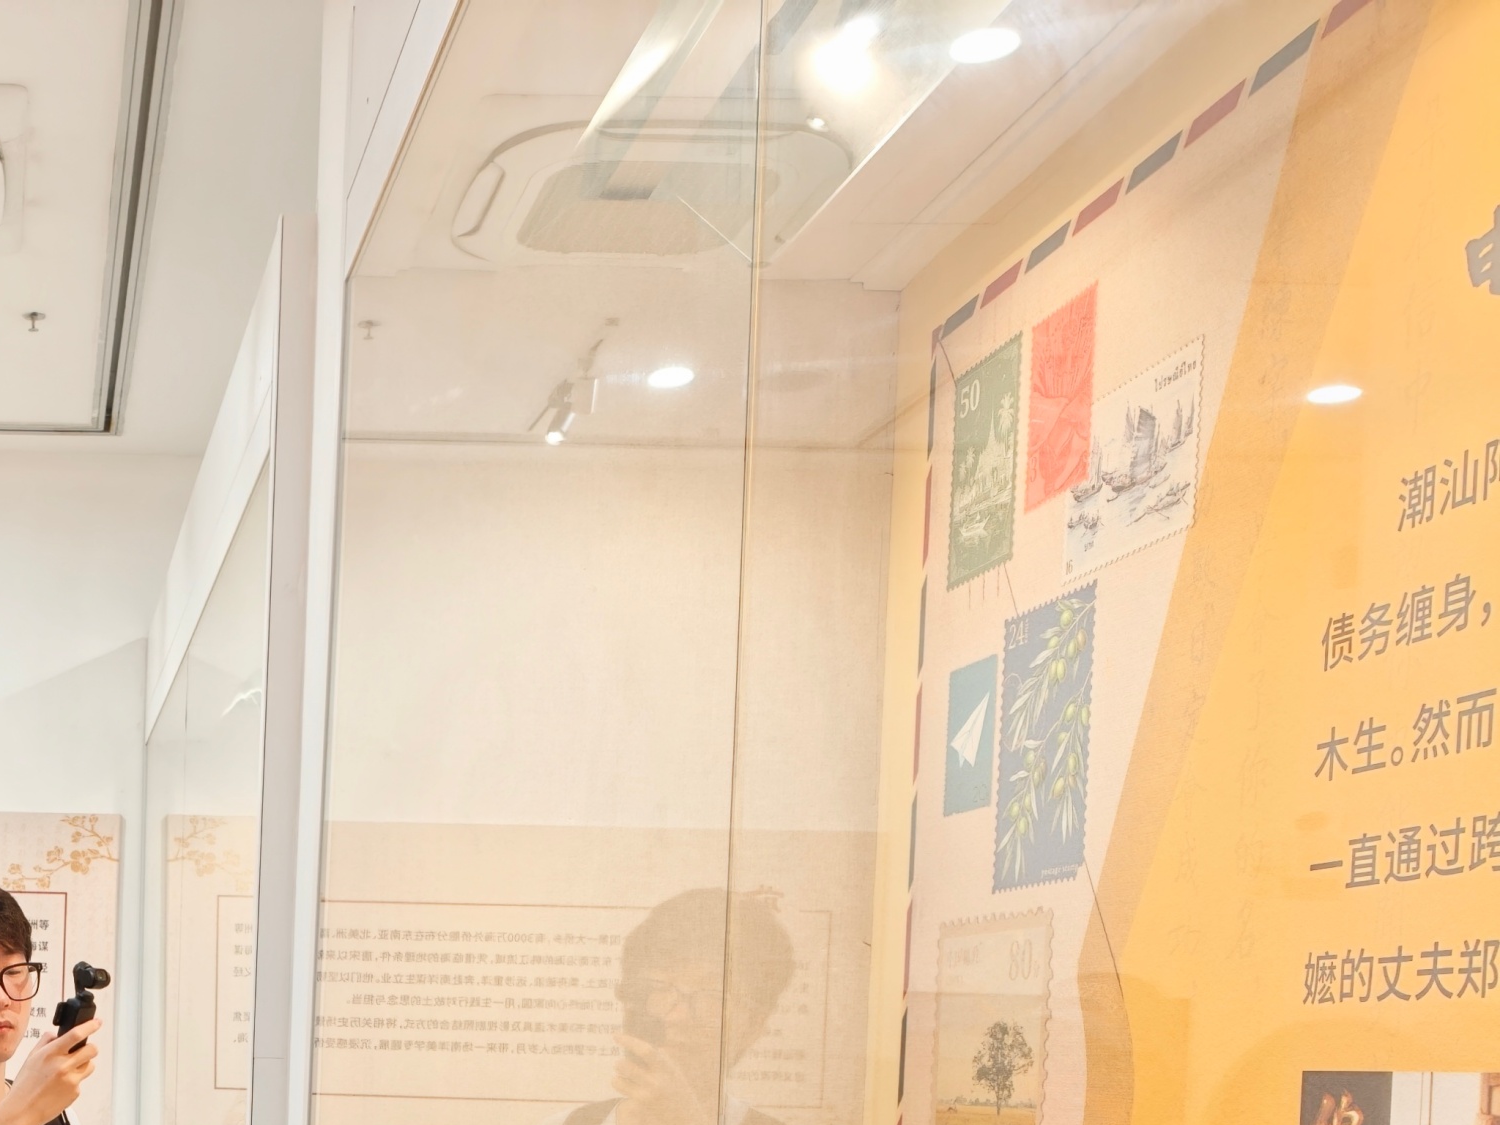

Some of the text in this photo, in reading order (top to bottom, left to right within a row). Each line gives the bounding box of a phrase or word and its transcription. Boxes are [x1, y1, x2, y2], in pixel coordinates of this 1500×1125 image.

[959, 378, 981, 419] 50
[1008, 620, 1026, 650] 24
[1321, 573, 1493, 673] 债务缠身，
[1314, 687, 1497, 784] 木生。然而
[1008, 938, 1033, 982] 80
